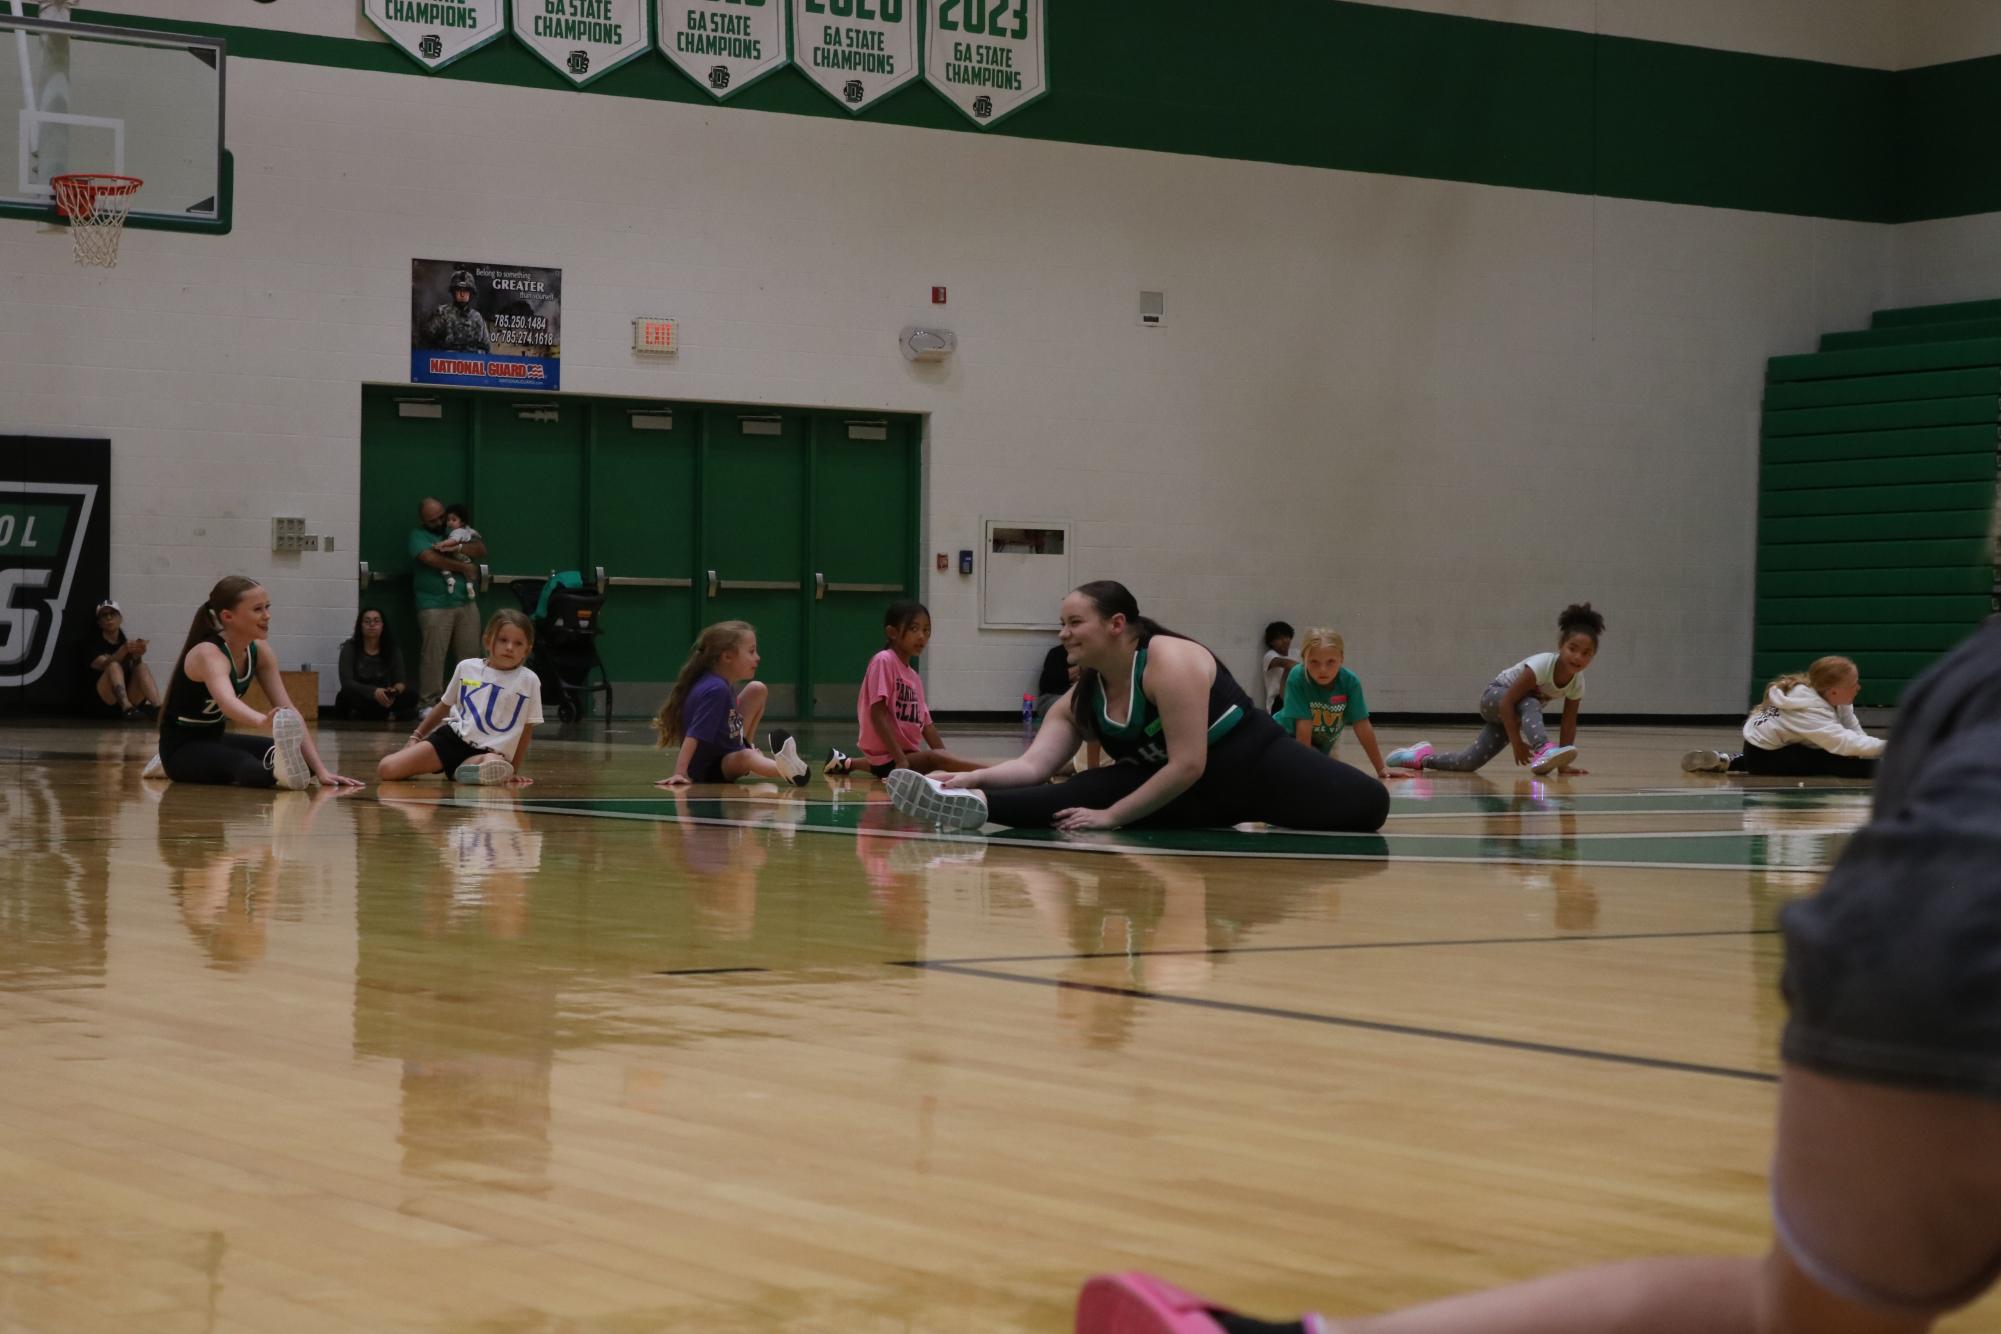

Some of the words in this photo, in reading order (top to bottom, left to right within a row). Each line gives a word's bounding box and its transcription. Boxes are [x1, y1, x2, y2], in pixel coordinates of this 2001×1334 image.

[385, 0, 477, 29] CHAMPIONS
[569, 0, 612, 21] STATE
[687, 10, 707, 32] 6A
[710, 12, 751, 37] STATE
[939, 0, 1028, 40] 2023
[534, 15, 622, 45] CHAMPIONS
[823, 25, 842, 47] 6A
[846, 28, 884, 52] STATE
[677, 31, 761, 60] CHAMPIONS
[954, 42, 973, 63] 6A
[976, 44, 1013, 68] STATE
[813, 46, 895, 75] CHAMPIONS
[945, 62, 1022, 91] CHAMPIONS
[476, 268, 496, 279] Belong
[503, 271, 531, 281] something
[492, 278, 545, 293] GREATER
[494, 314, 546, 330] 785.250.1484
[490, 332, 500, 342] or
[502, 330, 553, 346] 785.274.1618
[430, 359, 486, 376] NATIONAL
[487, 361, 528, 378] GUARD
[459, 678, 530, 736] KU
